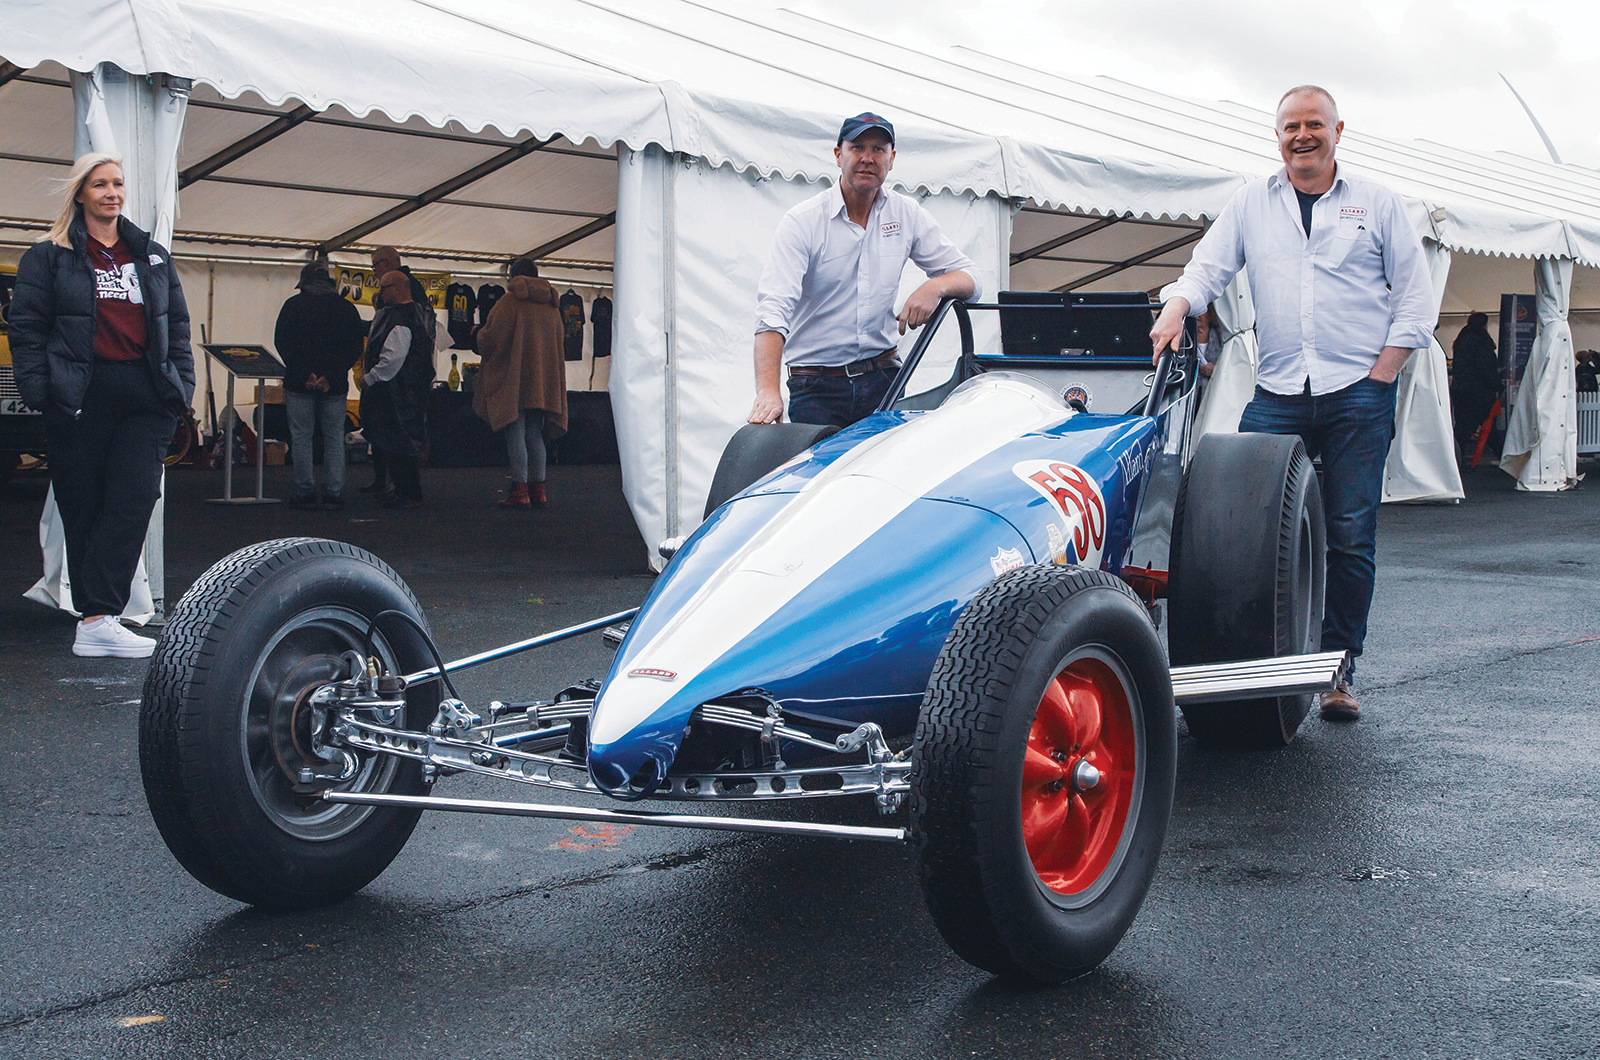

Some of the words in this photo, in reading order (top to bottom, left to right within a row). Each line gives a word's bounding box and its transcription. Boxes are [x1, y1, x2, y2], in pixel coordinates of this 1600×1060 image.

[99, 291, 127, 299] need
[453, 294, 467, 312] 60
[1028, 463, 1105, 562] 58
[634, 669, 672, 677] ALLARD
